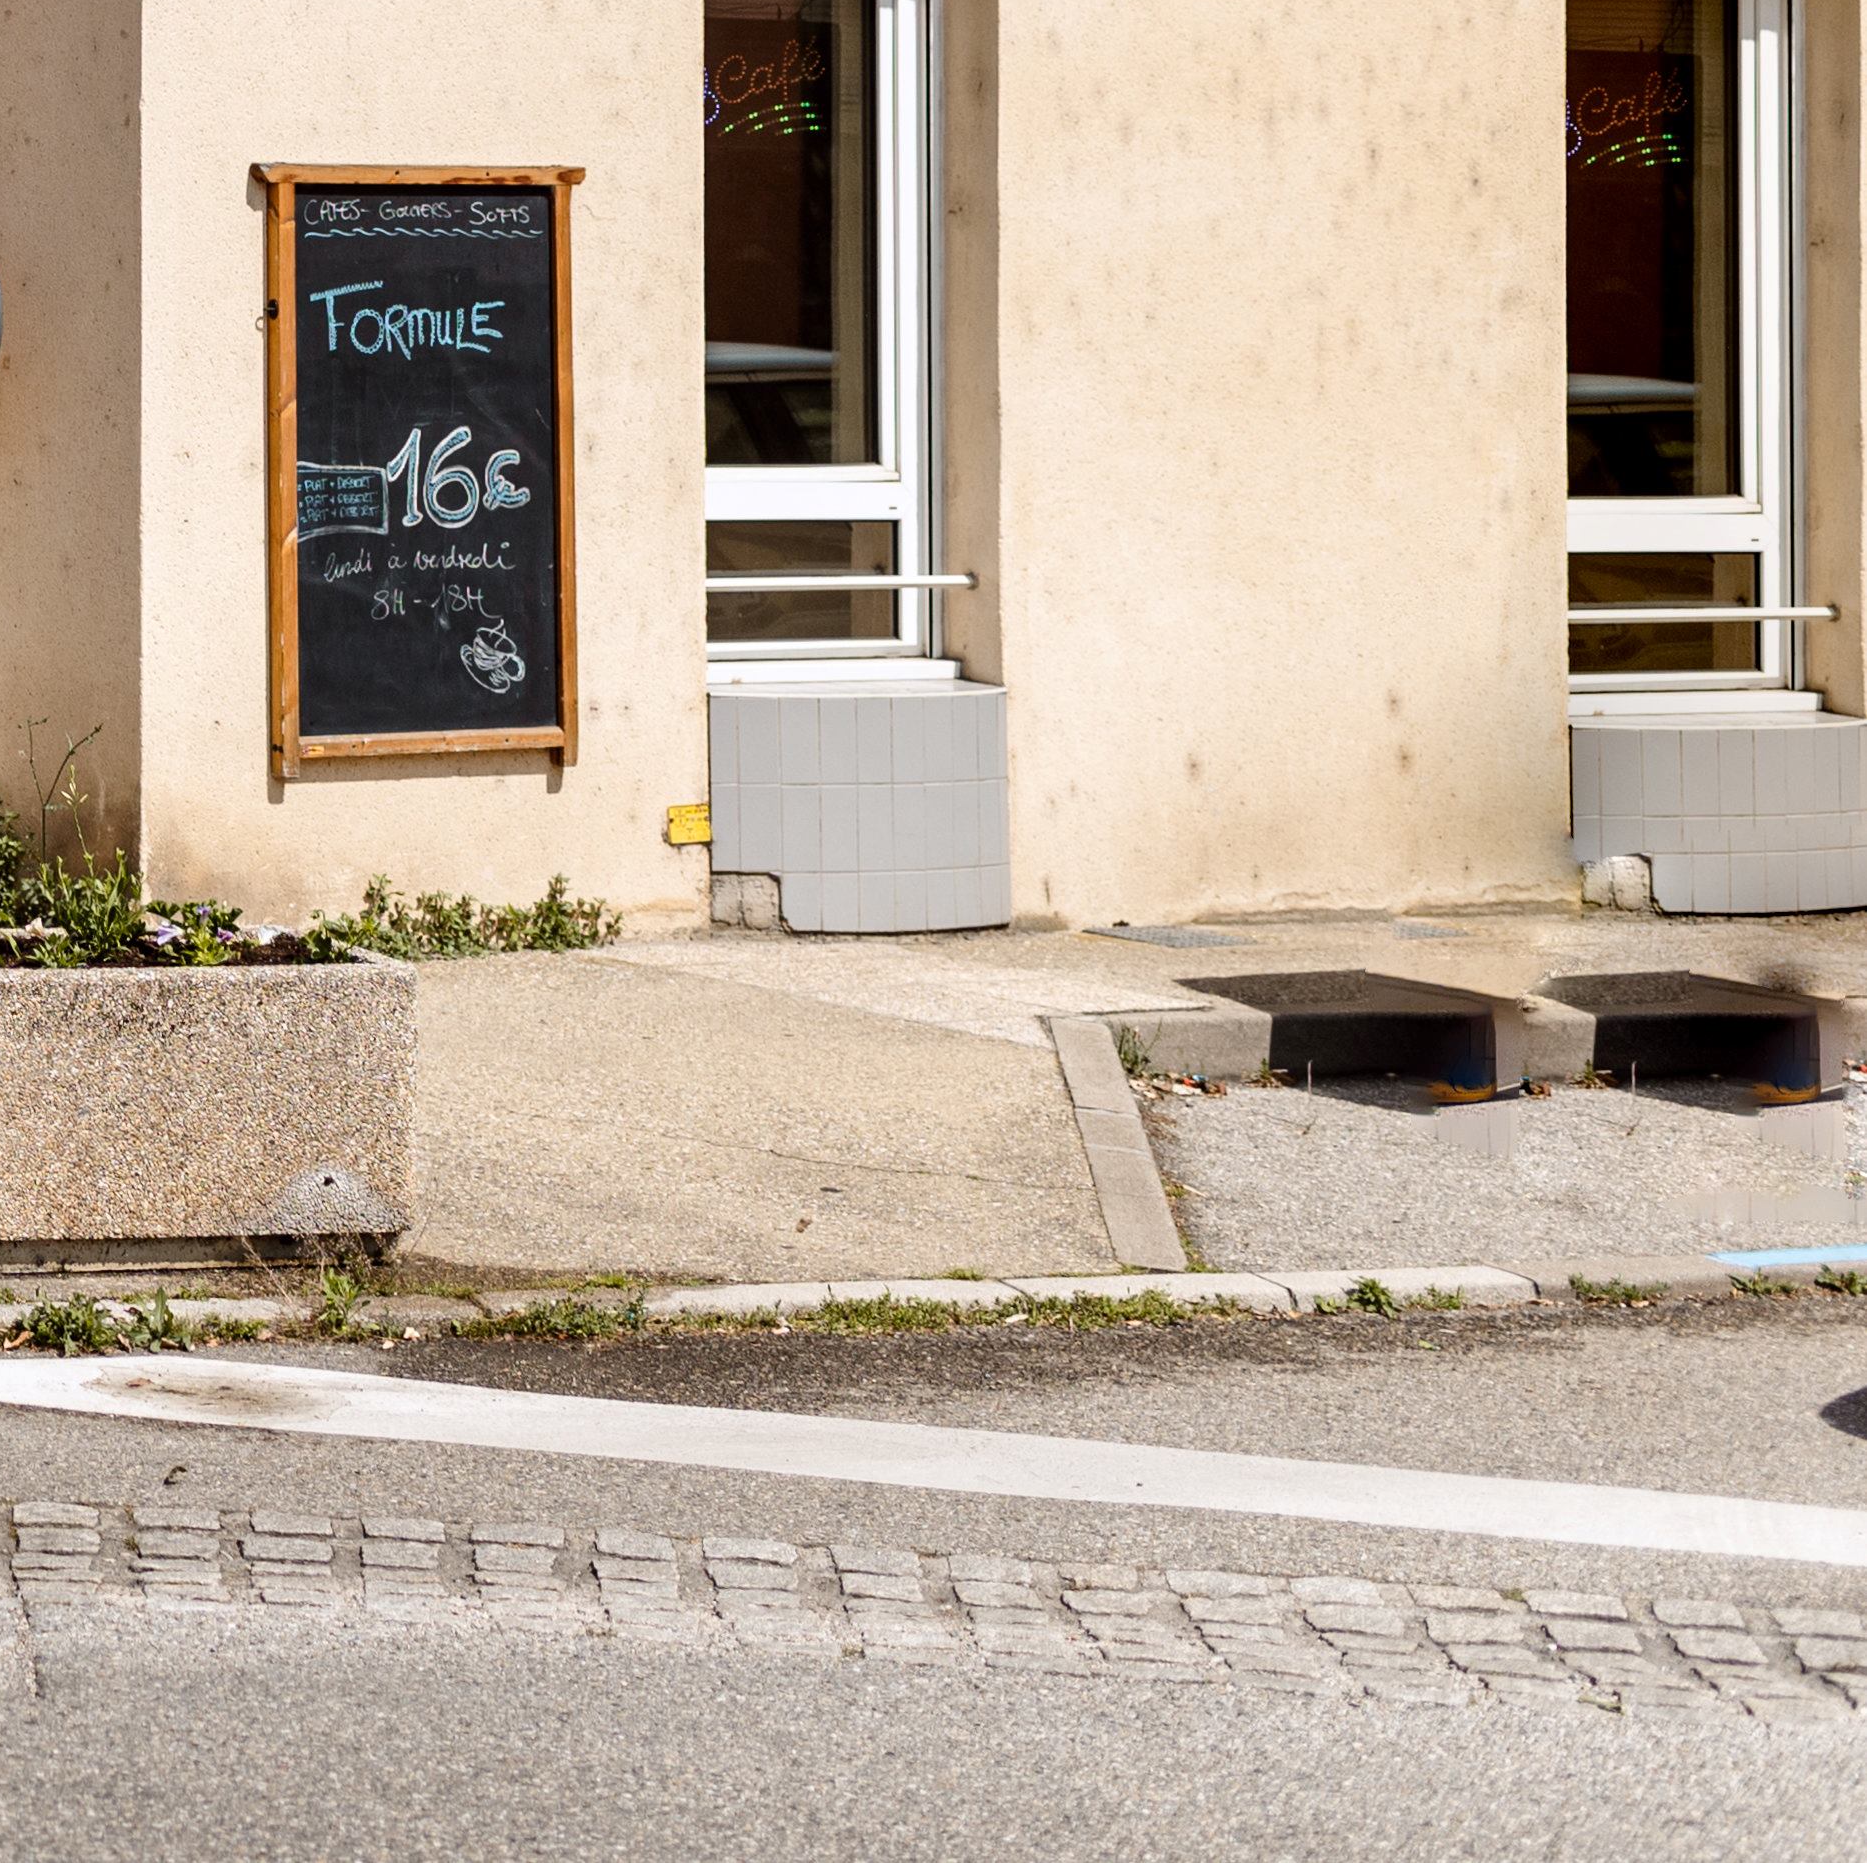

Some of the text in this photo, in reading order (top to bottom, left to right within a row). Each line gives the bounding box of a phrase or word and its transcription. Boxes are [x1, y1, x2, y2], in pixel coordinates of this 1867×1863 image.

[309, 280, 506, 361] FORMULE
[324, 542, 516, 582] lundi à vendredi
